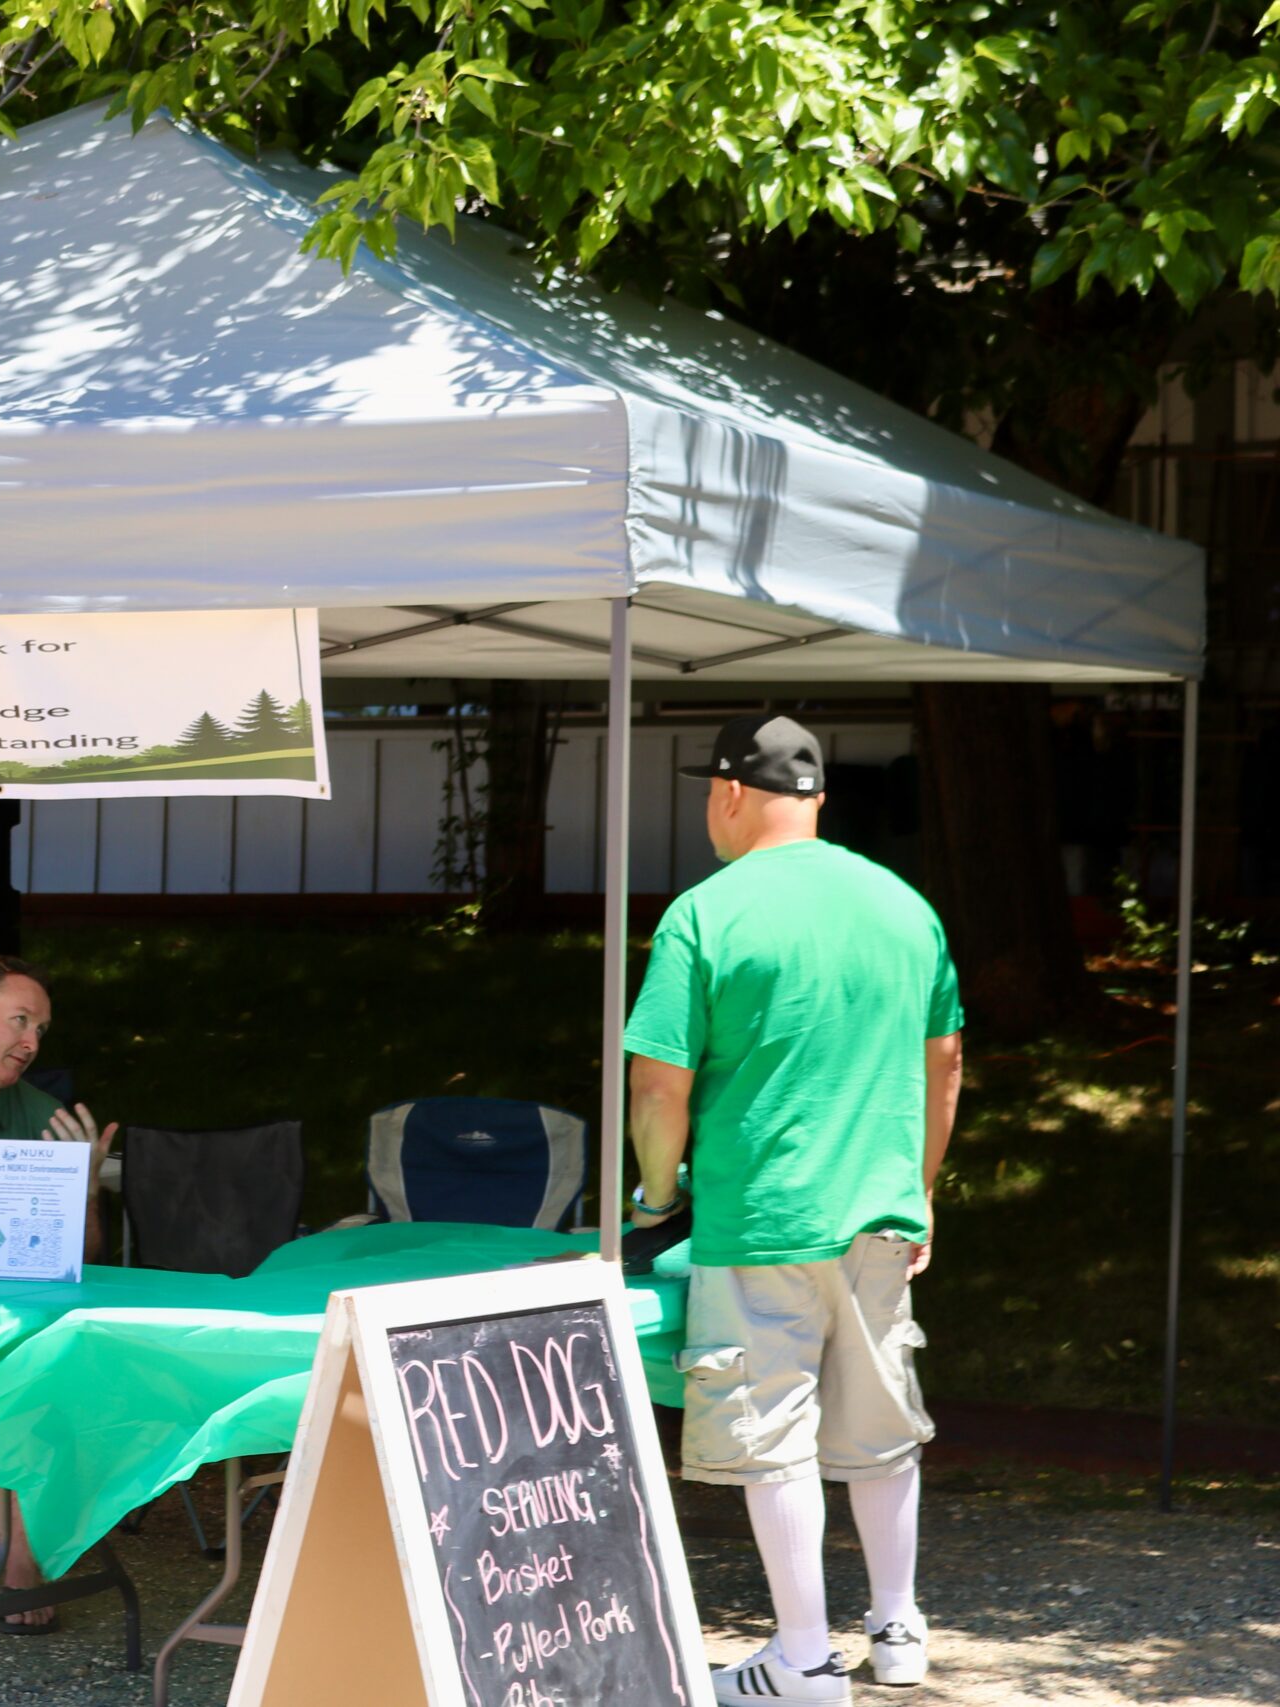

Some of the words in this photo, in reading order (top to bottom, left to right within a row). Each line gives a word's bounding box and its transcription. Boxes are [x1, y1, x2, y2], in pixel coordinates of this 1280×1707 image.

[22, 639, 78, 654] for
[20, 1148, 55, 1158] NUKU
[397, 1354, 508, 1482] RED
[510, 1333, 615, 1448] DOG
[575, 1593, 635, 1645] Pork
